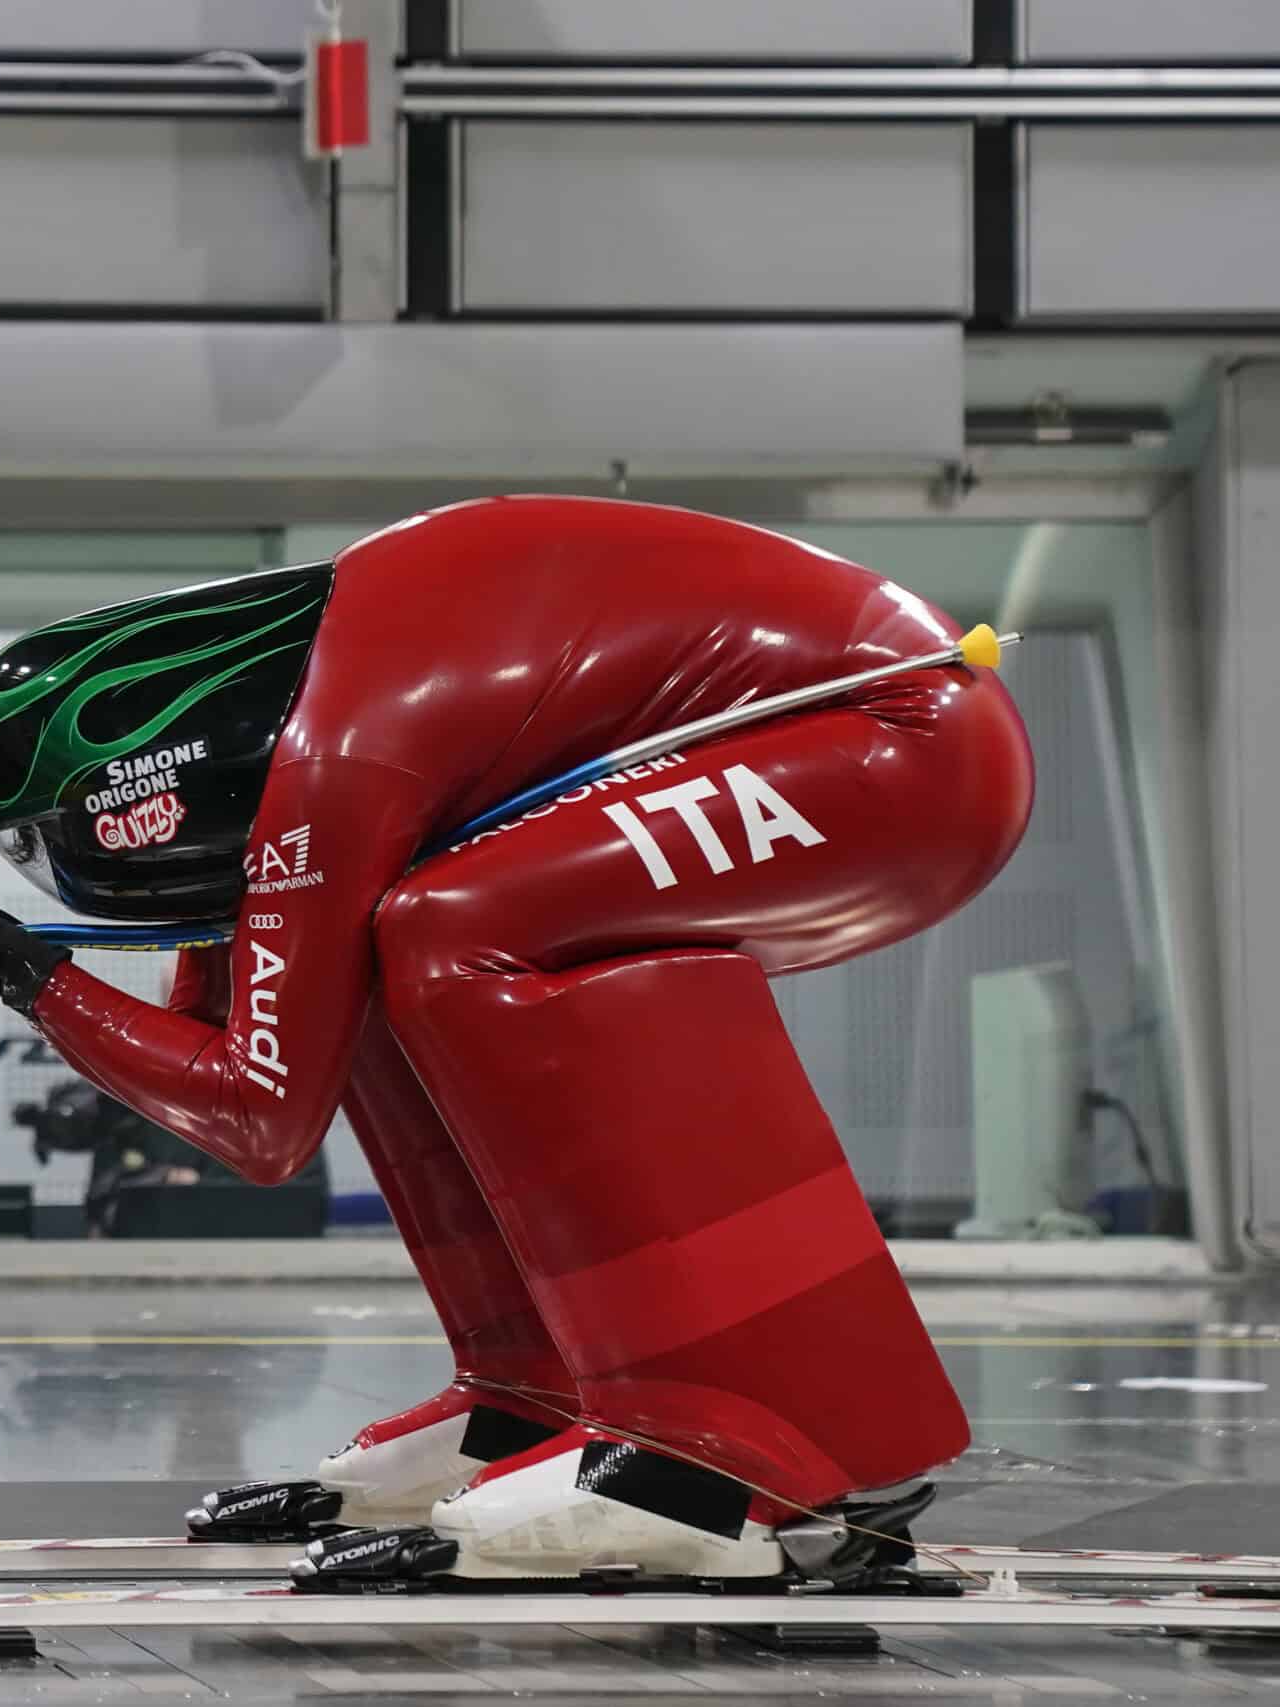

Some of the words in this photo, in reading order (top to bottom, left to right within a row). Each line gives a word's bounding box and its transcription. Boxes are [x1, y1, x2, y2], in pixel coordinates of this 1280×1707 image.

[85, 768, 180, 814] ORIGONE
[601, 763, 827, 890] ITA
[246, 939, 288, 1099] Audi
[215, 1488, 289, 1519] ATOMIC
[320, 1536, 400, 1568] ATOMIC
